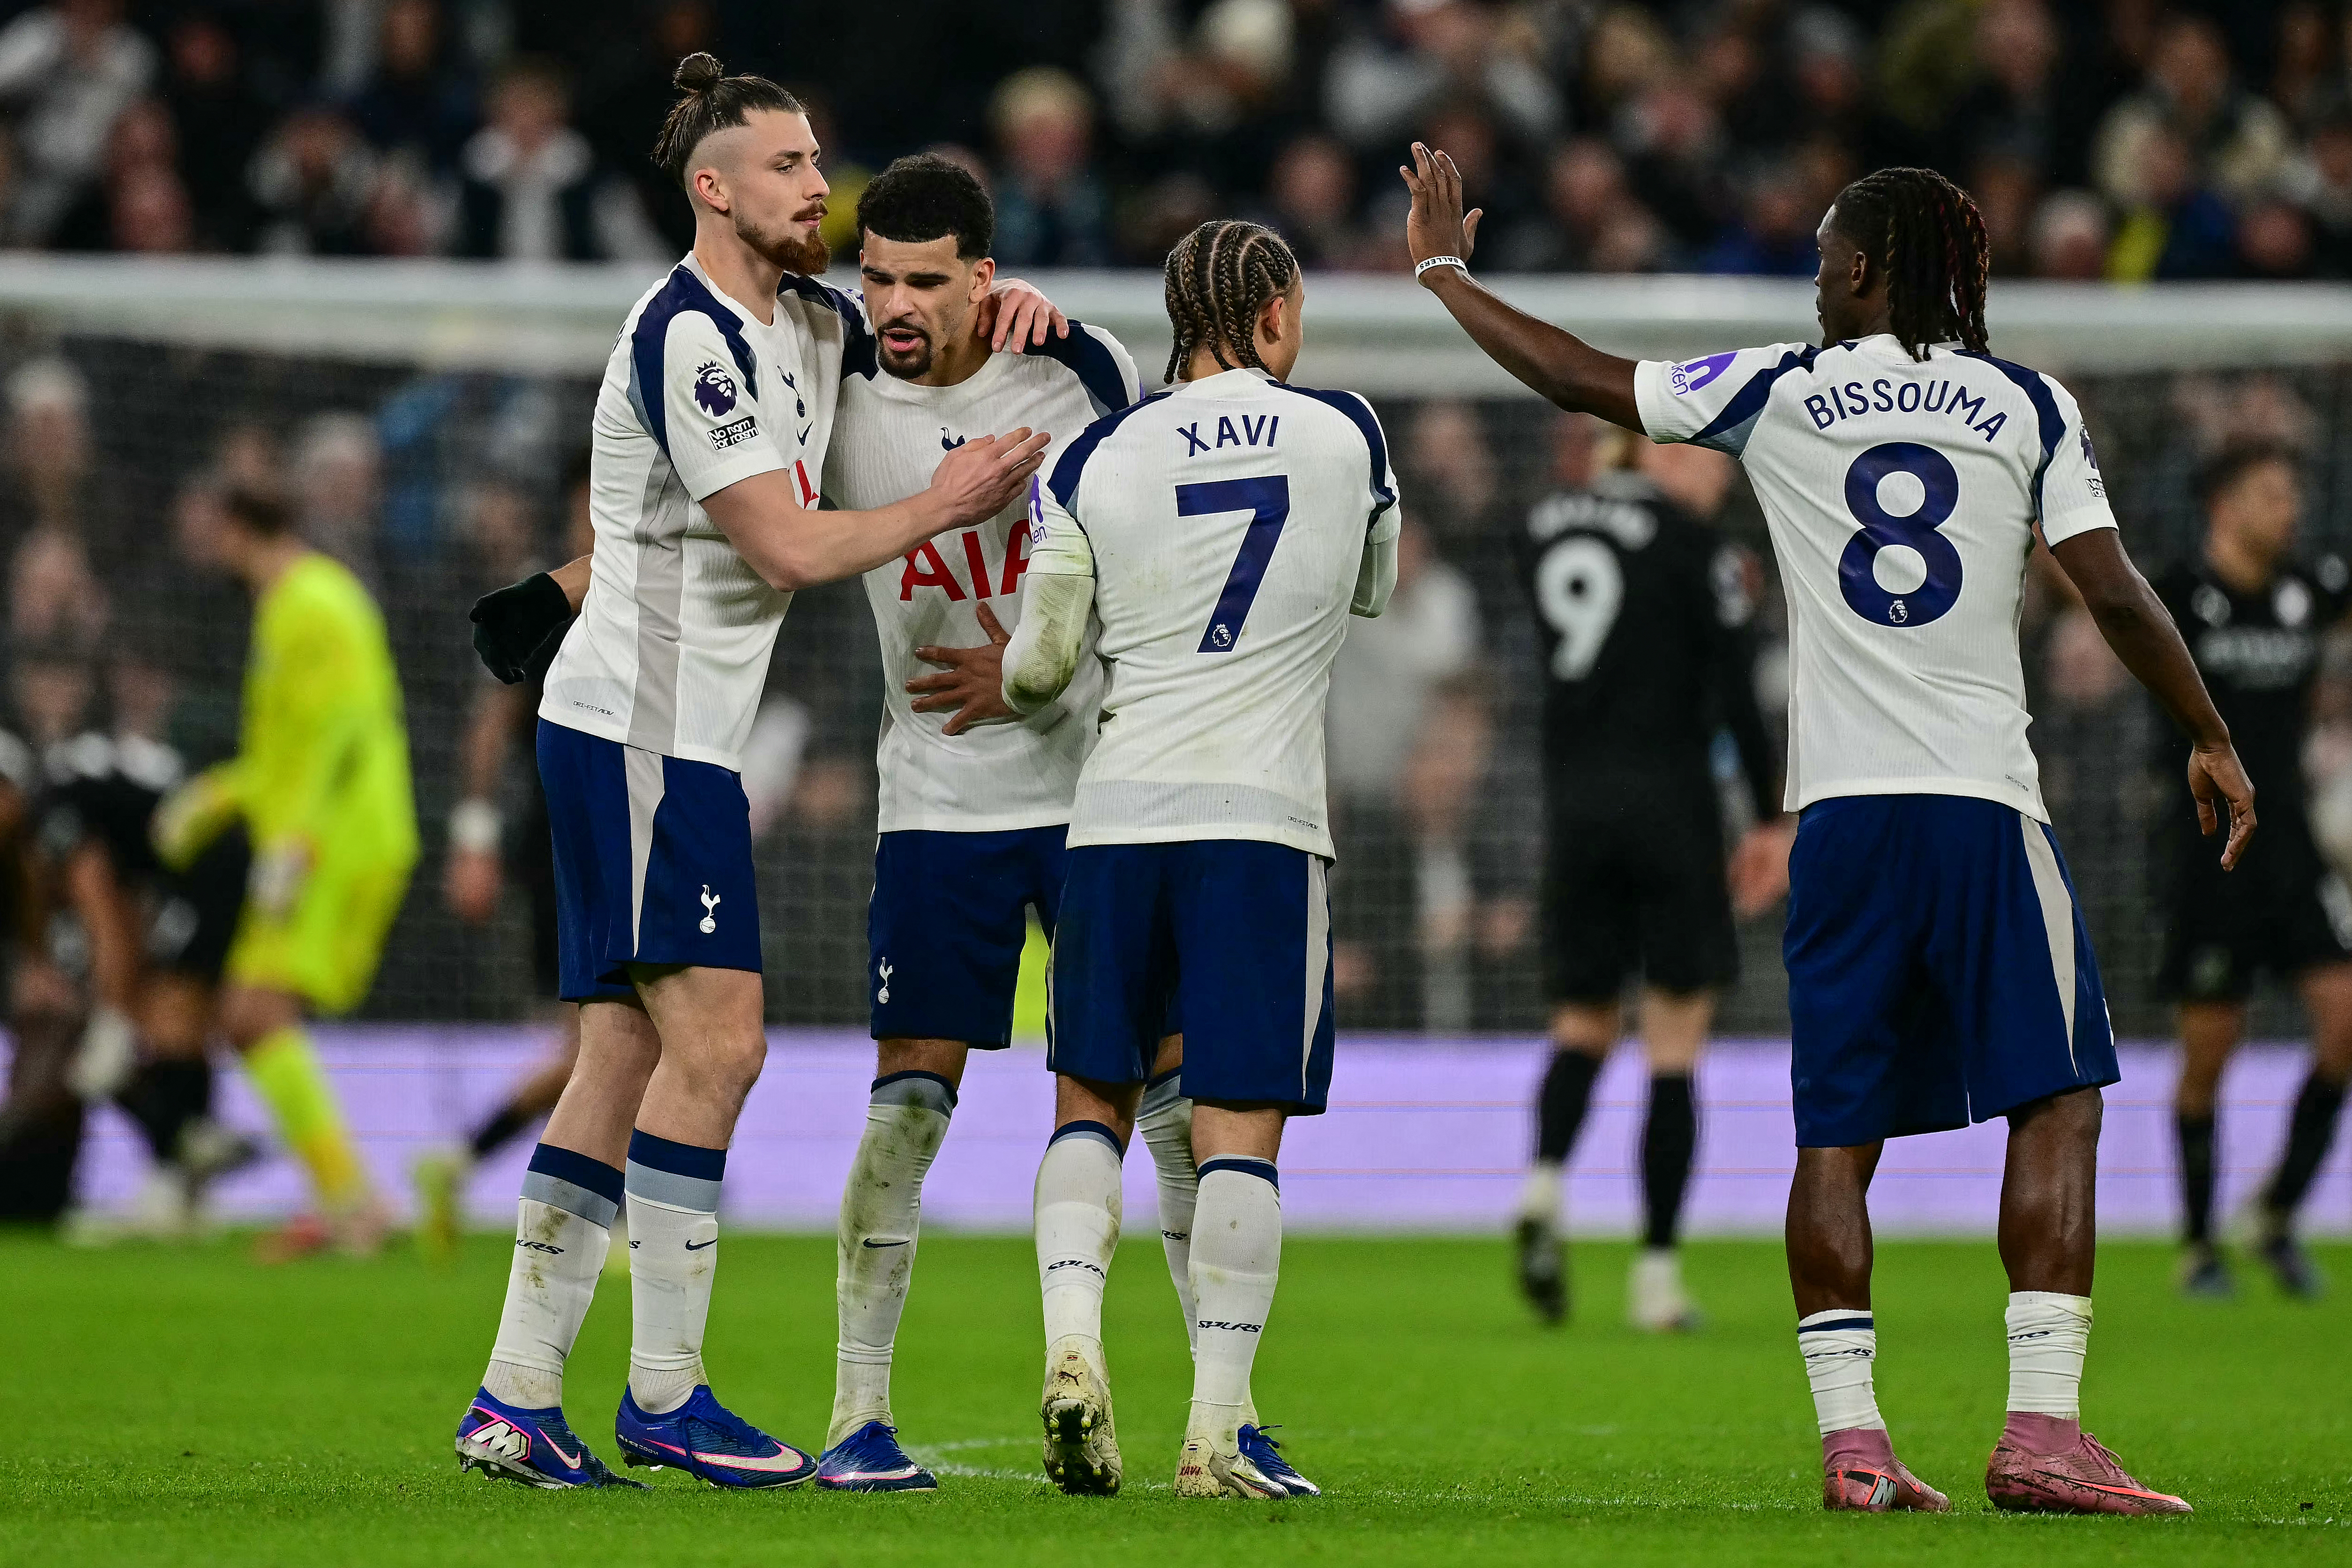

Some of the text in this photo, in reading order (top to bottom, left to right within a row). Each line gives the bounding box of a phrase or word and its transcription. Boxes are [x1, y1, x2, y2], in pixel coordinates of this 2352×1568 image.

[1420, 257, 1459, 270] BALLERS
[1804, 379, 2007, 443] BISSOUMA
[708, 429, 727, 440] No
[712, 427, 758, 450] for racsm
[1176, 414, 1280, 457] XAVI
[1838, 441, 1963, 628] 8
[1175, 474, 1290, 653] 7
[1536, 535, 1625, 681] 9
[1198, 1320, 1262, 1333] SPURS
